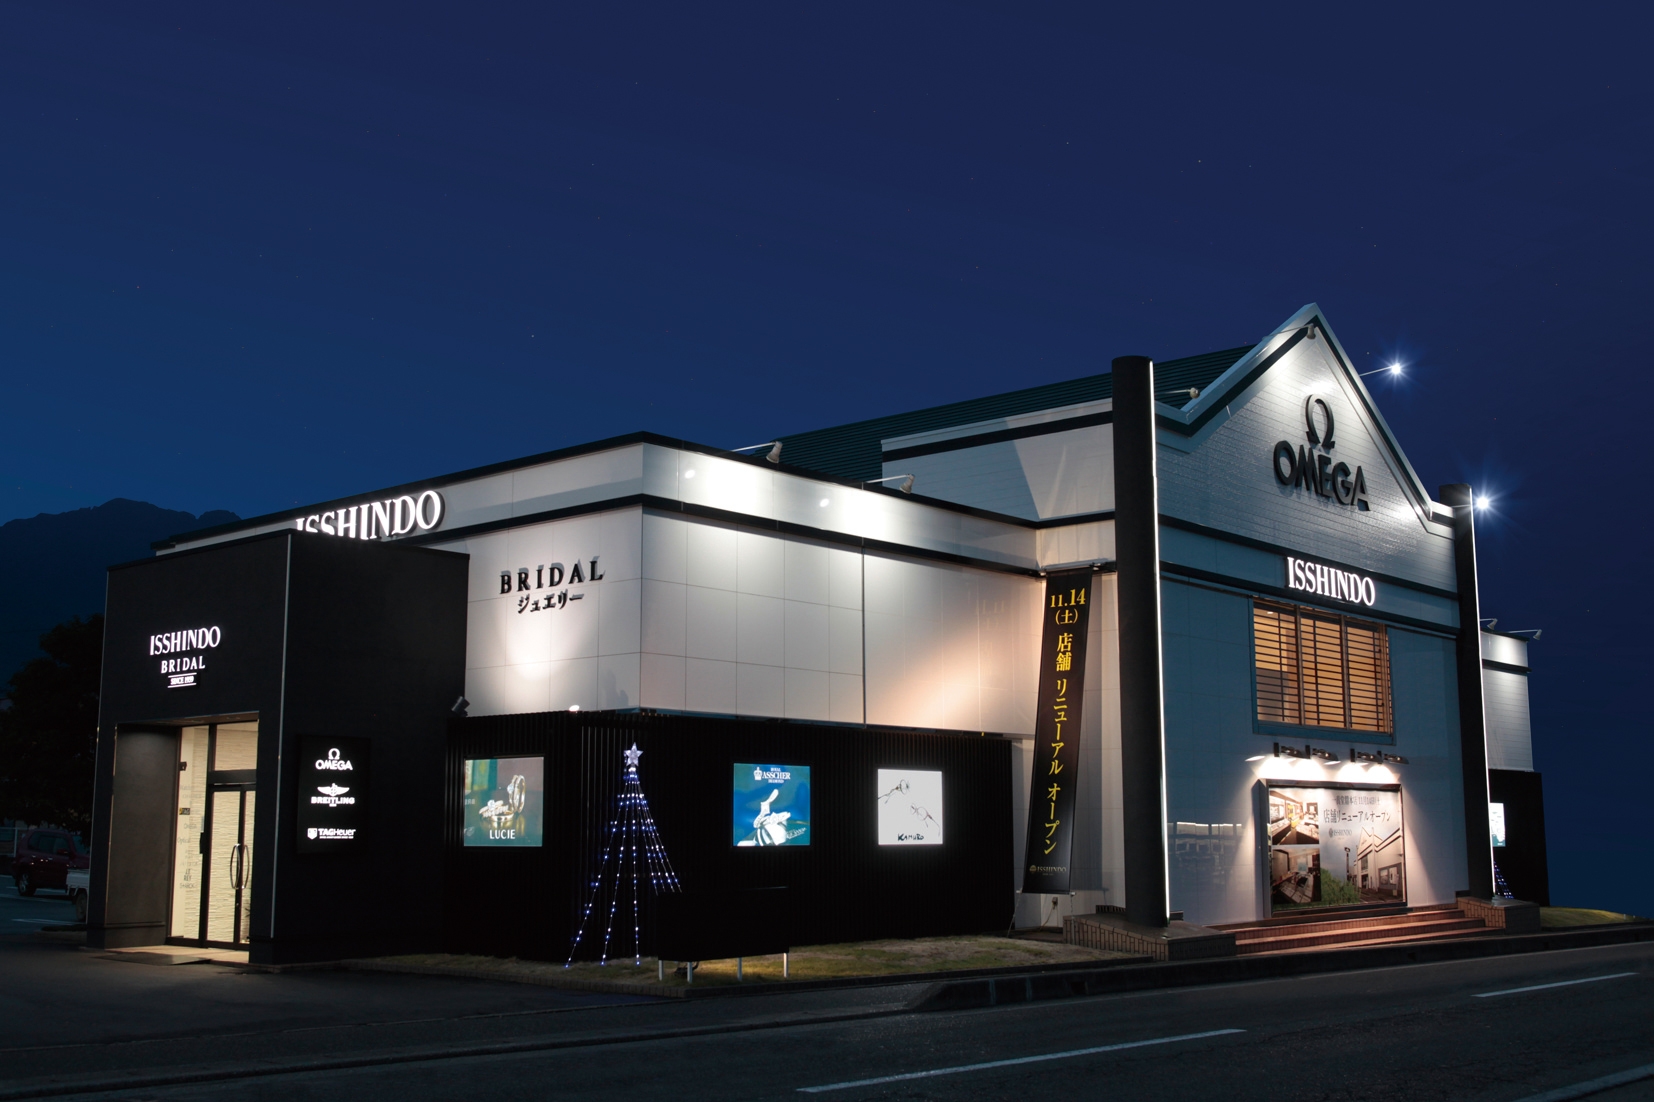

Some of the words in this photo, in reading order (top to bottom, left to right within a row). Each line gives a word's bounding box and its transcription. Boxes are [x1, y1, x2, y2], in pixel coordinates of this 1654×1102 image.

[1273, 440, 1370, 511] OMEGA
[499, 560, 604, 594] BRIDAL
[1287, 556, 1375, 606] ISSHINDO
[518, 591, 585, 614] ジュエリー
[1050, 588, 1086, 607] 11.14
[150, 626, 221, 655] ISSHINDO
[161, 655, 206, 673] BRIDAL
[315, 759, 353, 770] OMEGA
[762, 771, 791, 780] ASSCHER
[311, 796, 355, 804] BREITLING
[489, 829, 516, 840] LUCIE
